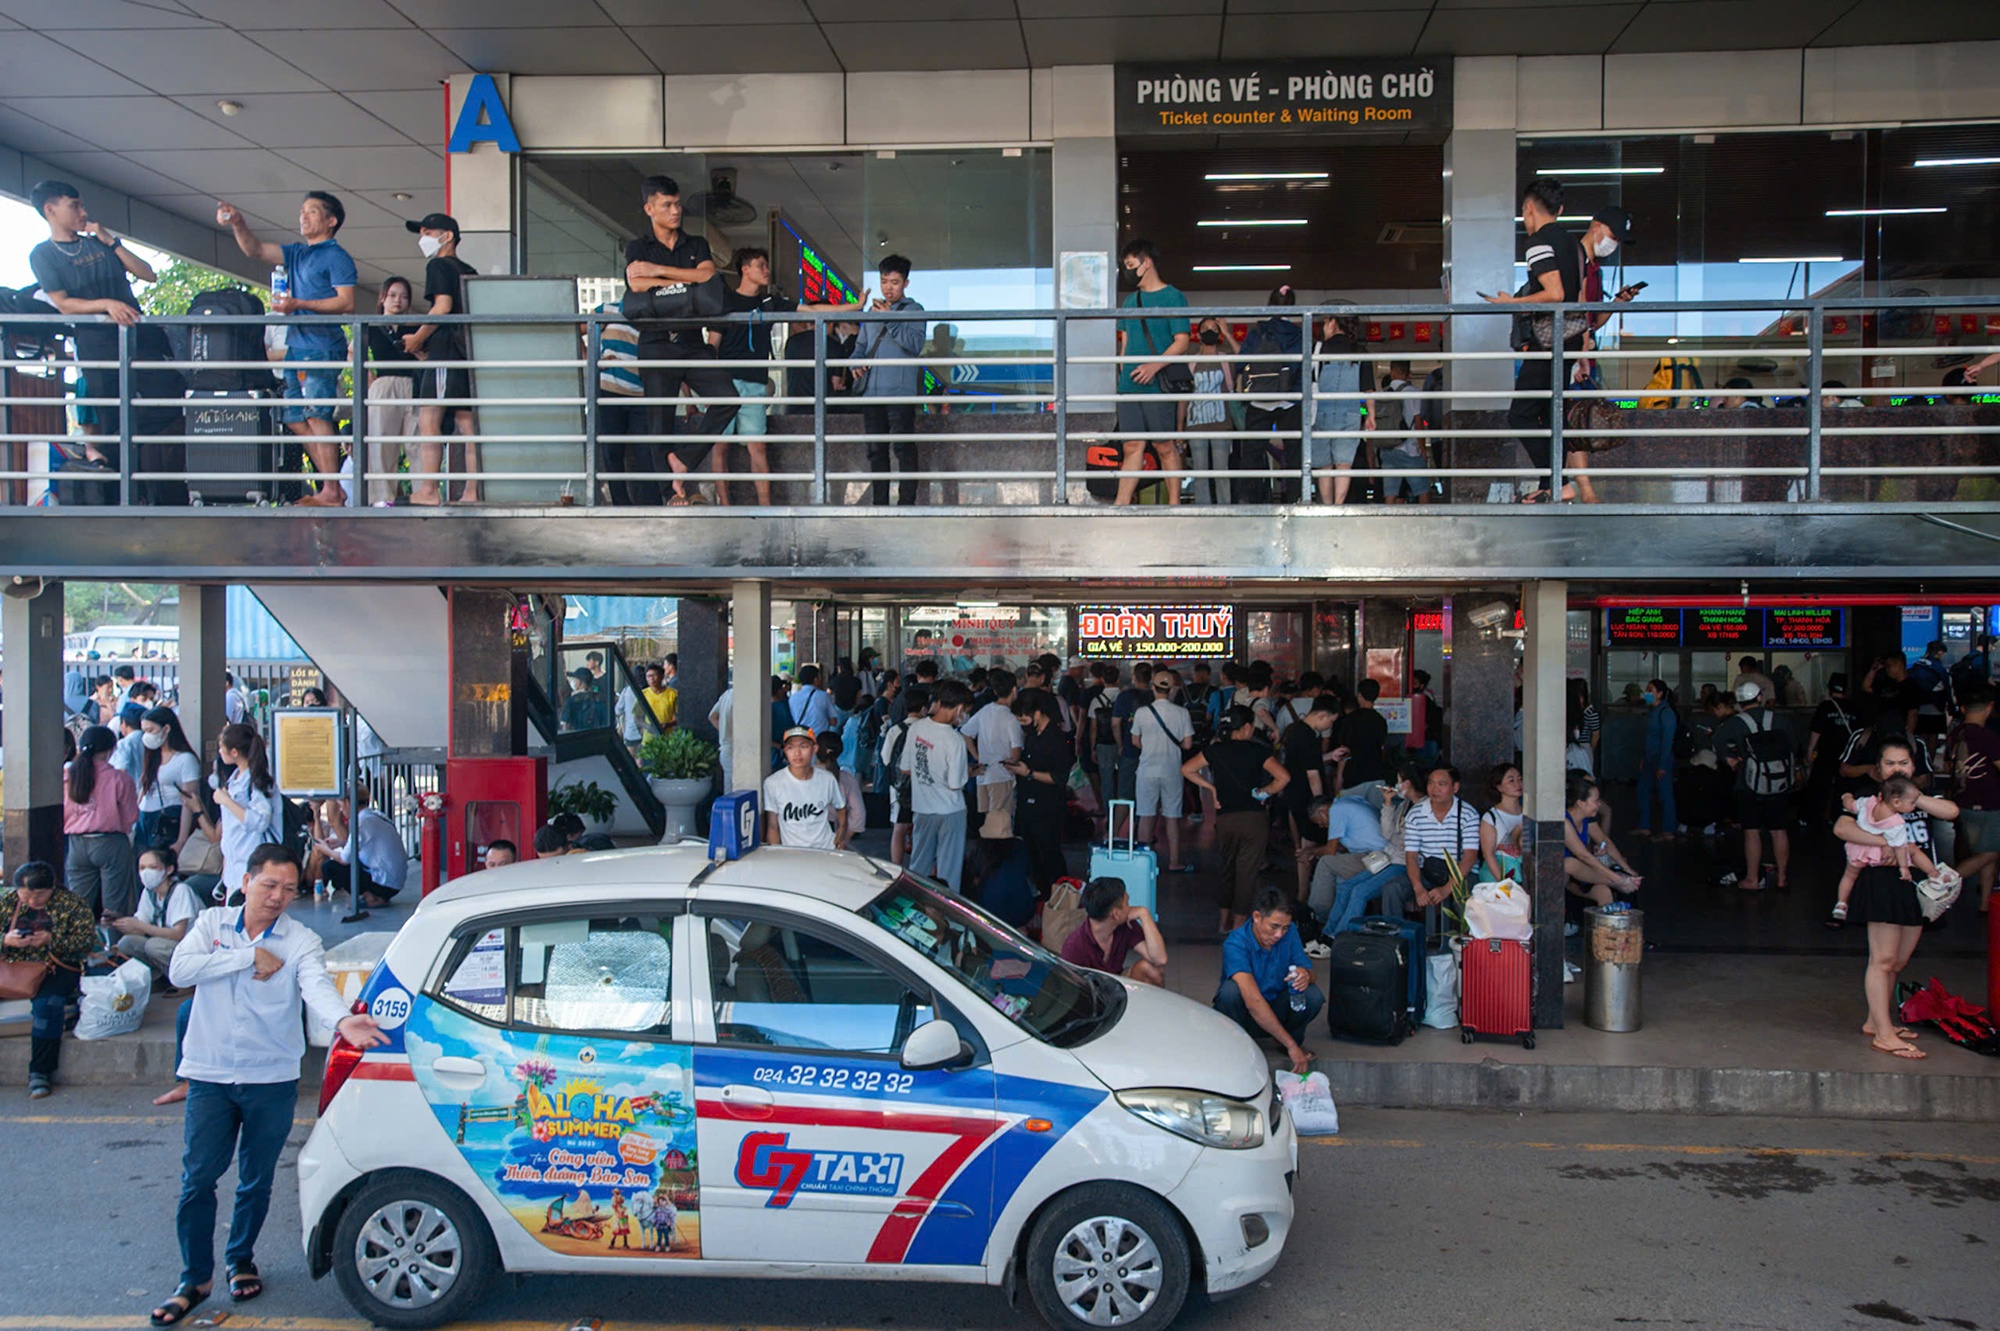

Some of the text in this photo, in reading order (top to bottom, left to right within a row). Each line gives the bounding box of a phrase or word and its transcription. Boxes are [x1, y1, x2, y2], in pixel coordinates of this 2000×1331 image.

[1137, 73, 1221, 103] PHÒNG
[1229, 71, 1261, 102] VÉ
[1288, 70, 1372, 100] PHÒNG
[1381, 67, 1435, 98] CHỜ
[447, 74, 521, 153] A
[1159, 106, 1412, 125] Ticket counter & Waiting Room
[951, 618, 985, 629] MINH
[1080, 605, 1232, 638] ĐOÀN THUÝ
[1087, 640, 1107, 652] GIÁ
[374, 998, 409, 1018] 3159
[819, 1068, 849, 1089] 32
[851, 1070, 881, 1091] 32
[884, 1073, 914, 1094] 32
[534, 1092, 636, 1125] ALOHA
[545, 1118, 622, 1140] SUMMER
[548, 1148, 584, 1169] Công
[586, 1150, 617, 1166] viên
[736, 1131, 900, 1208] G7 TAXI
[503, 1164, 541, 1182] Thiên
